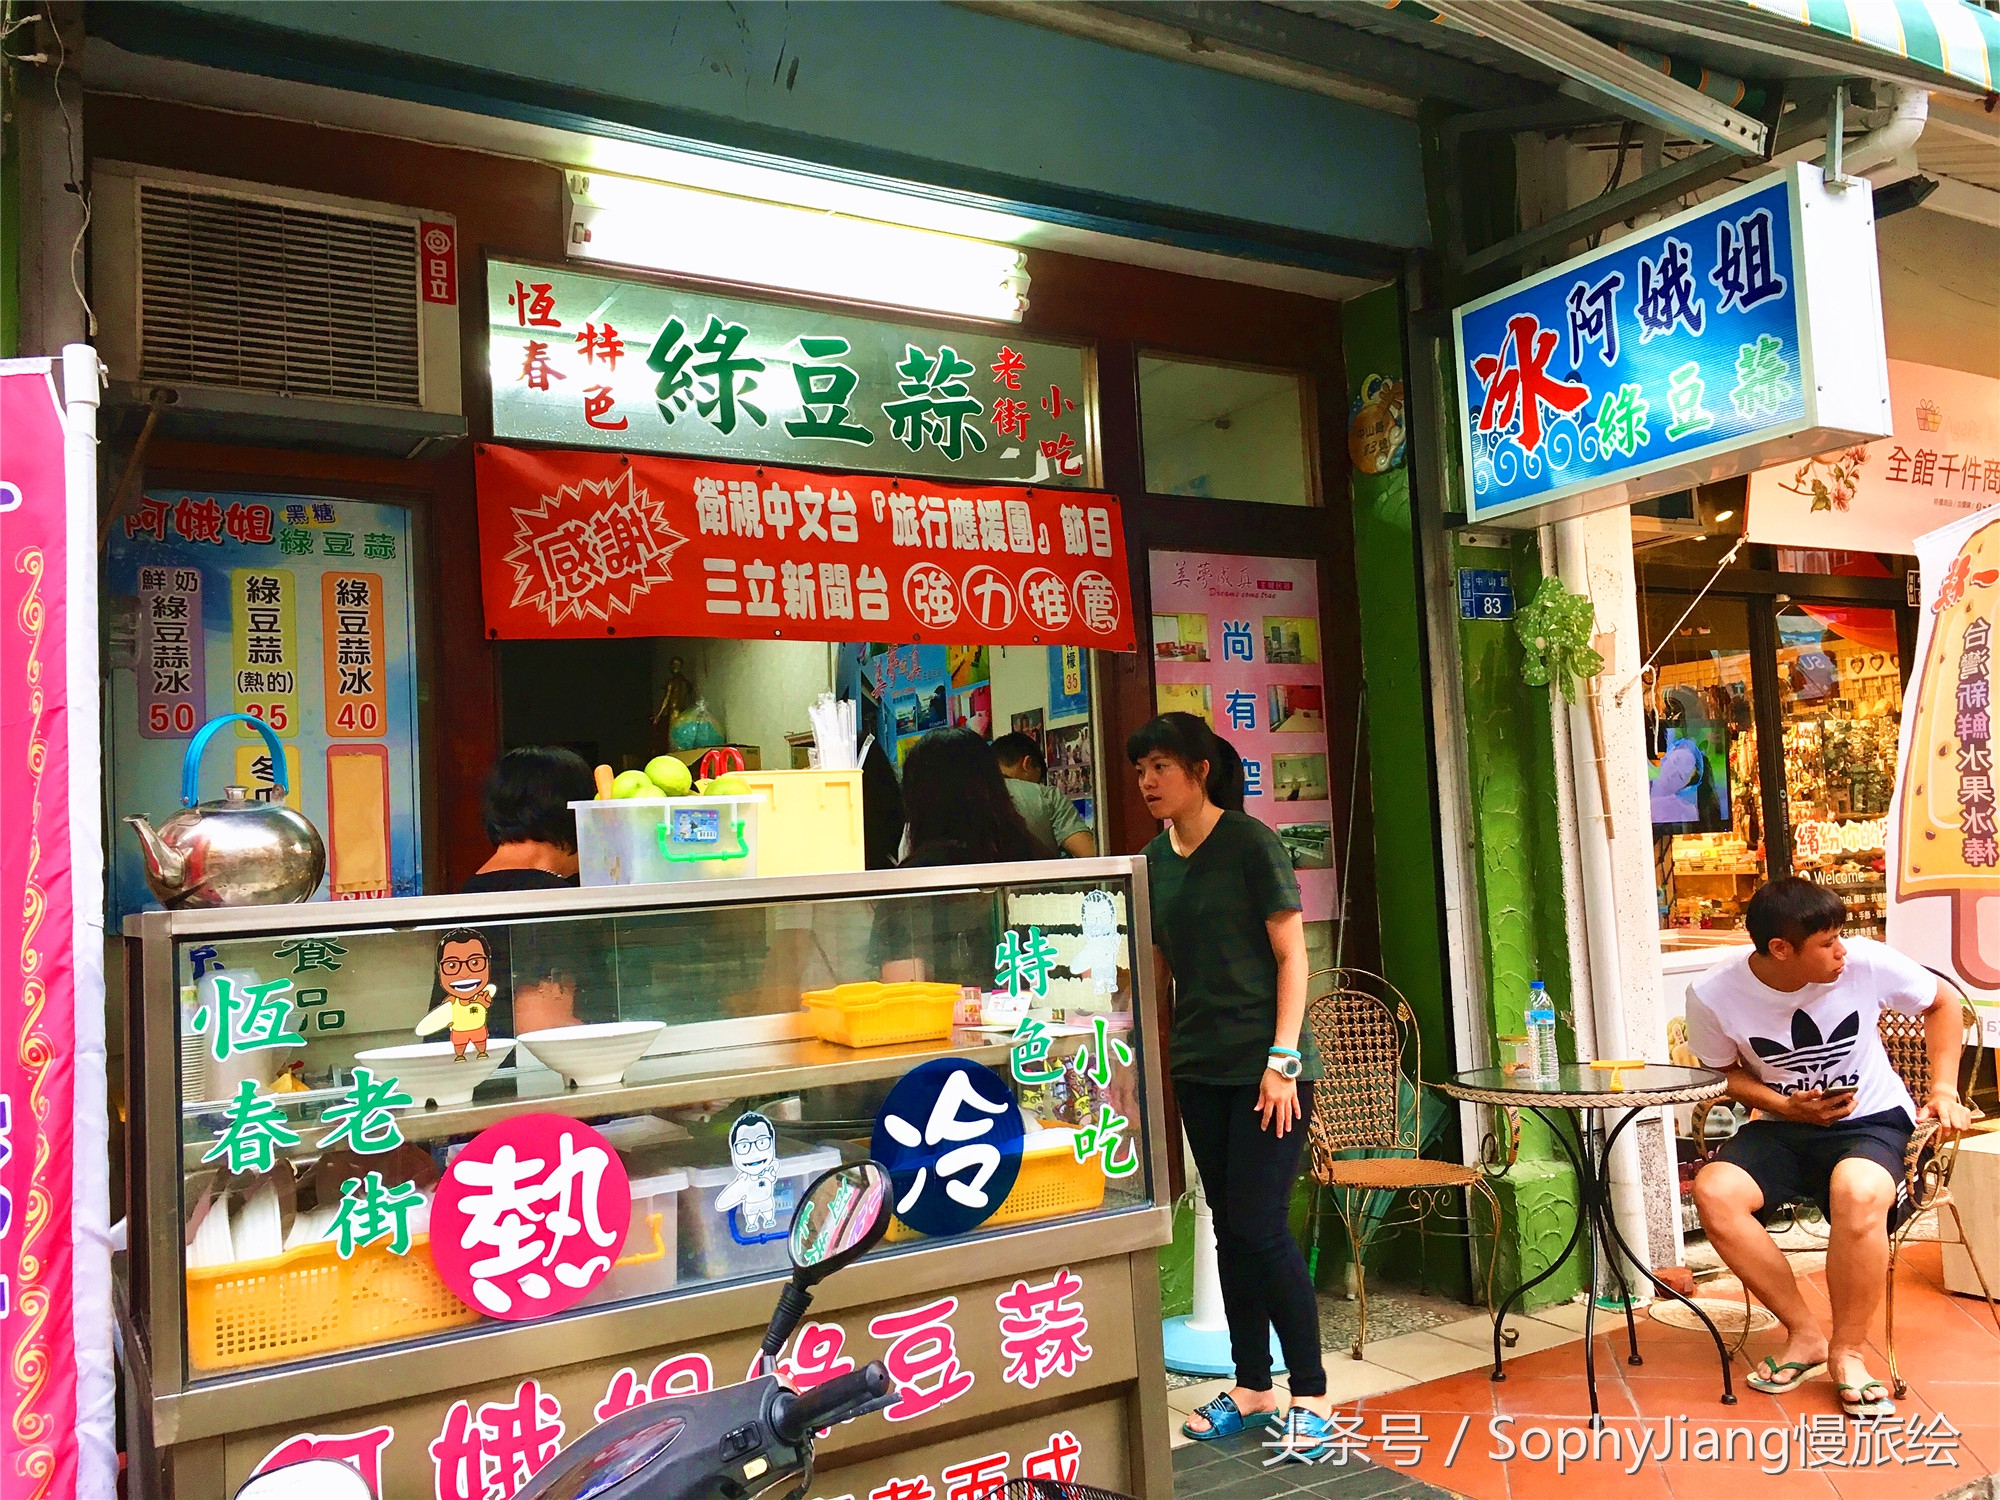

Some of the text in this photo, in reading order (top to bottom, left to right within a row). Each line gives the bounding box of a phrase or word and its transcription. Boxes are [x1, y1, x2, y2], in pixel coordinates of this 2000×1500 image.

[430, 258, 449, 299] 日立
[1566, 207, 1789, 368] 阿娥姐
[508, 279, 568, 392] 恆春
[575, 321, 629, 431] 特色
[1470, 312, 1590, 453] 冰
[645, 313, 988, 463] 綠豆蒜
[990, 345, 1032, 442] 老街
[1040, 384, 1083, 476] 小吃
[1596, 332, 1794, 460] 綠豆蒜
[124, 496, 274, 544] 阿娥姐
[280, 527, 397, 559] 綠豆蒜
[285, 503, 336, 524] 黑糖
[533, 501, 659, 601] 感謝
[141, 570, 199, 593] 鮮奶
[246, 576, 283, 665] 綠豆蒜
[703, 557, 1120, 634] 三立新聞台 強力推薦
[1483, 596, 1502, 615] 83
[152, 596, 190, 694] 綠豆蒜冰
[237, 671, 294, 694] (熱的)
[336, 579, 373, 695] 綠豆蒜冰
[1066, 673, 1079, 690] 35
[150, 703, 195, 732] 50
[246, 704, 288, 731] 35
[336, 703, 378, 730] 40
[1813, 869, 1865, 886] Welcome
[995, 926, 1066, 1085] 特色
[192, 976, 308, 1174] 恆春
[1073, 1018, 1140, 1179] 小吃
[1765, 1070, 1860, 1096] adidas
[316, 1066, 428, 1262] 老街
[884, 1069, 1010, 1215] 冷
[453, 1131, 612, 1311] 熱
